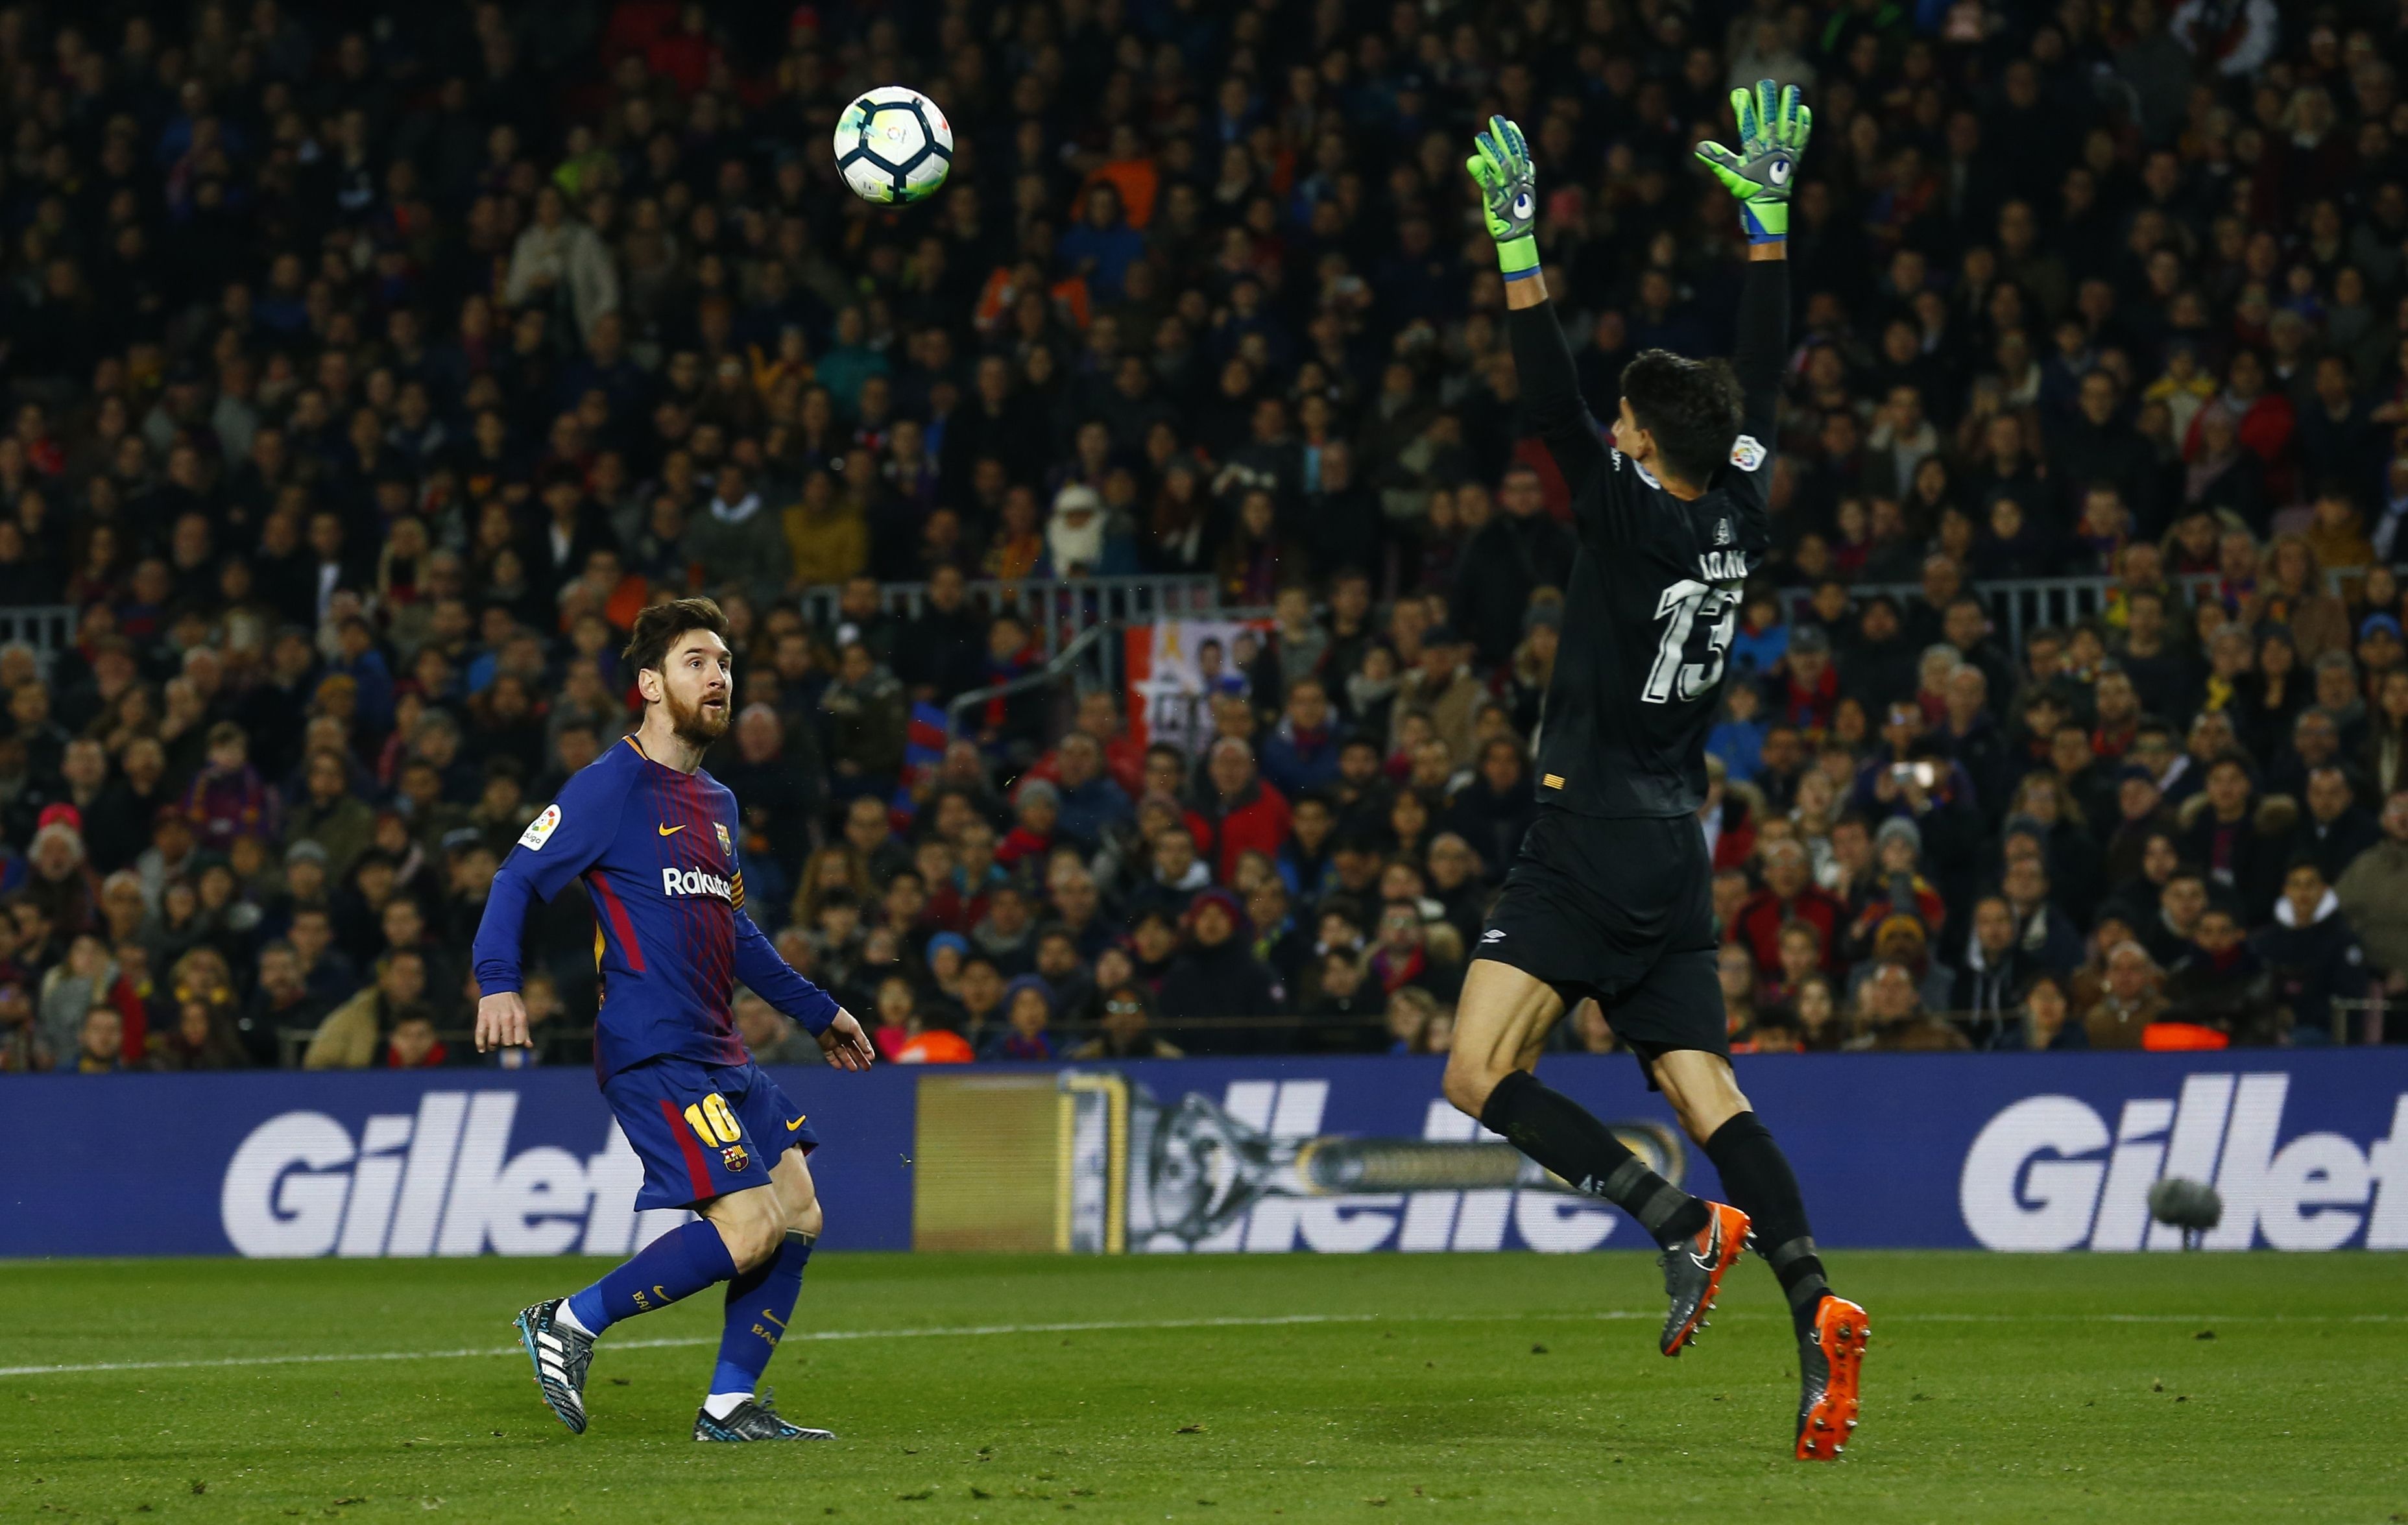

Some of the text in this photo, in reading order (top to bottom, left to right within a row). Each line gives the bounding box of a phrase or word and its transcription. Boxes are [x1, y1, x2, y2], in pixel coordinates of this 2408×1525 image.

[1640, 579, 1744, 704] 13
[662, 866, 731, 896] Rakute
[683, 1092, 741, 1148] 10
